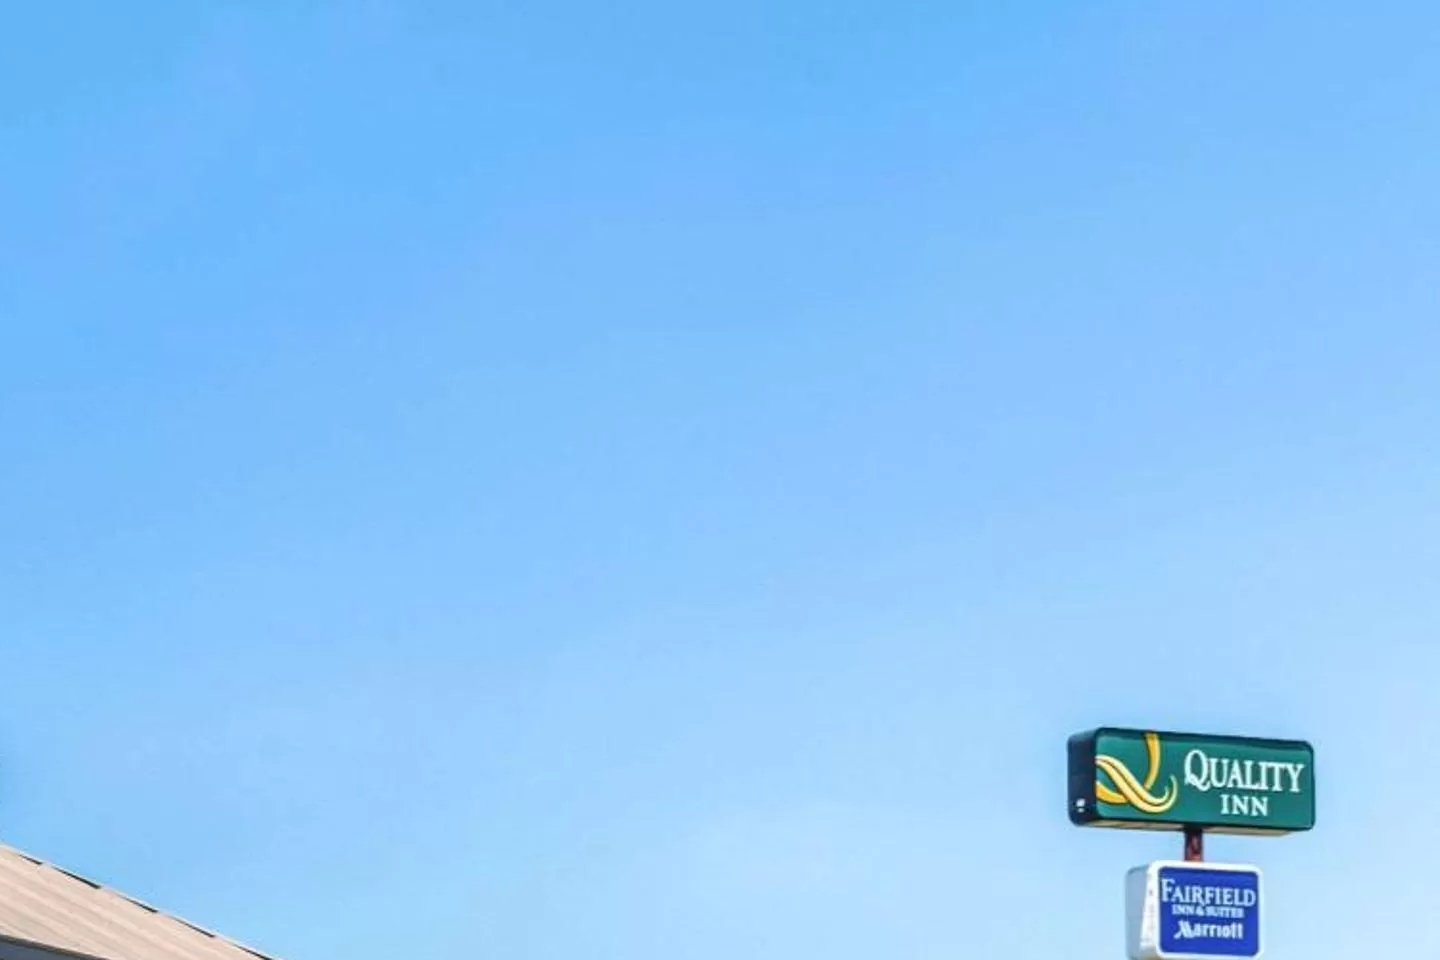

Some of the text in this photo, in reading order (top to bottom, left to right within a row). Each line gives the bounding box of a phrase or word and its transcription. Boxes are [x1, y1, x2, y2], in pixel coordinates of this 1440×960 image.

[1184, 749, 1305, 792] QUALITY
[1220, 794, 1269, 817] INN
[1161, 878, 1257, 907] FAIRFIELD
[1172, 904, 1195, 915] INN
[1195, 904, 1205, 917] &
[1173, 920, 1244, 939] Marriott
